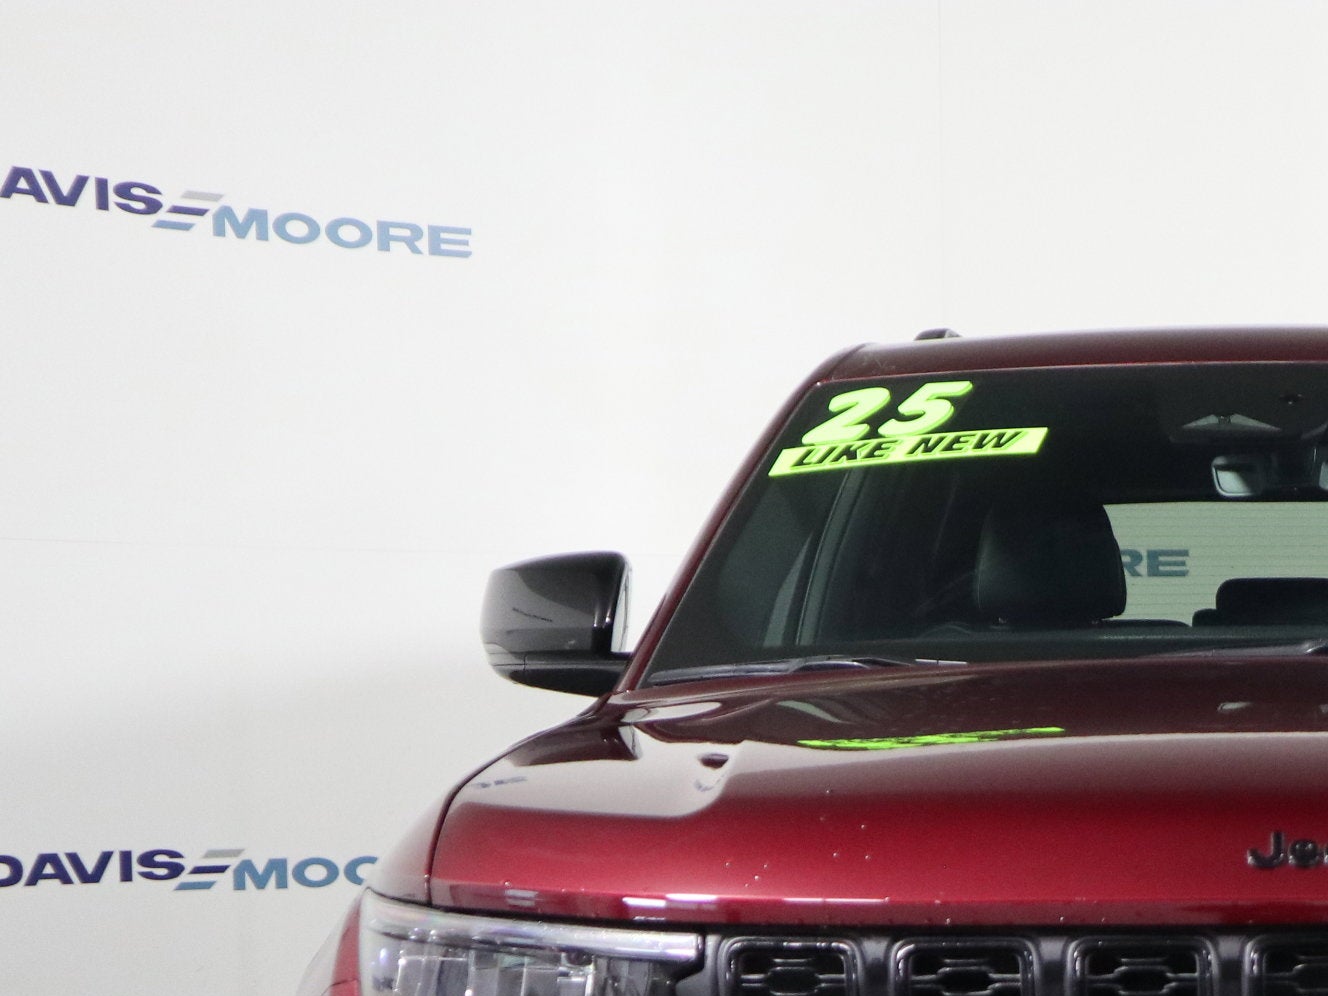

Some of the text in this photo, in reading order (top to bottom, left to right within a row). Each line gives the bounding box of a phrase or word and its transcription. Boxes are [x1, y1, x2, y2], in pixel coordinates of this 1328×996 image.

[0, 165, 473, 258] AVIS MOORE
[801, 380, 973, 445] 25
[791, 430, 1025, 468] LIKE NEW
[0, 848, 379, 891] DAVIS MOO
